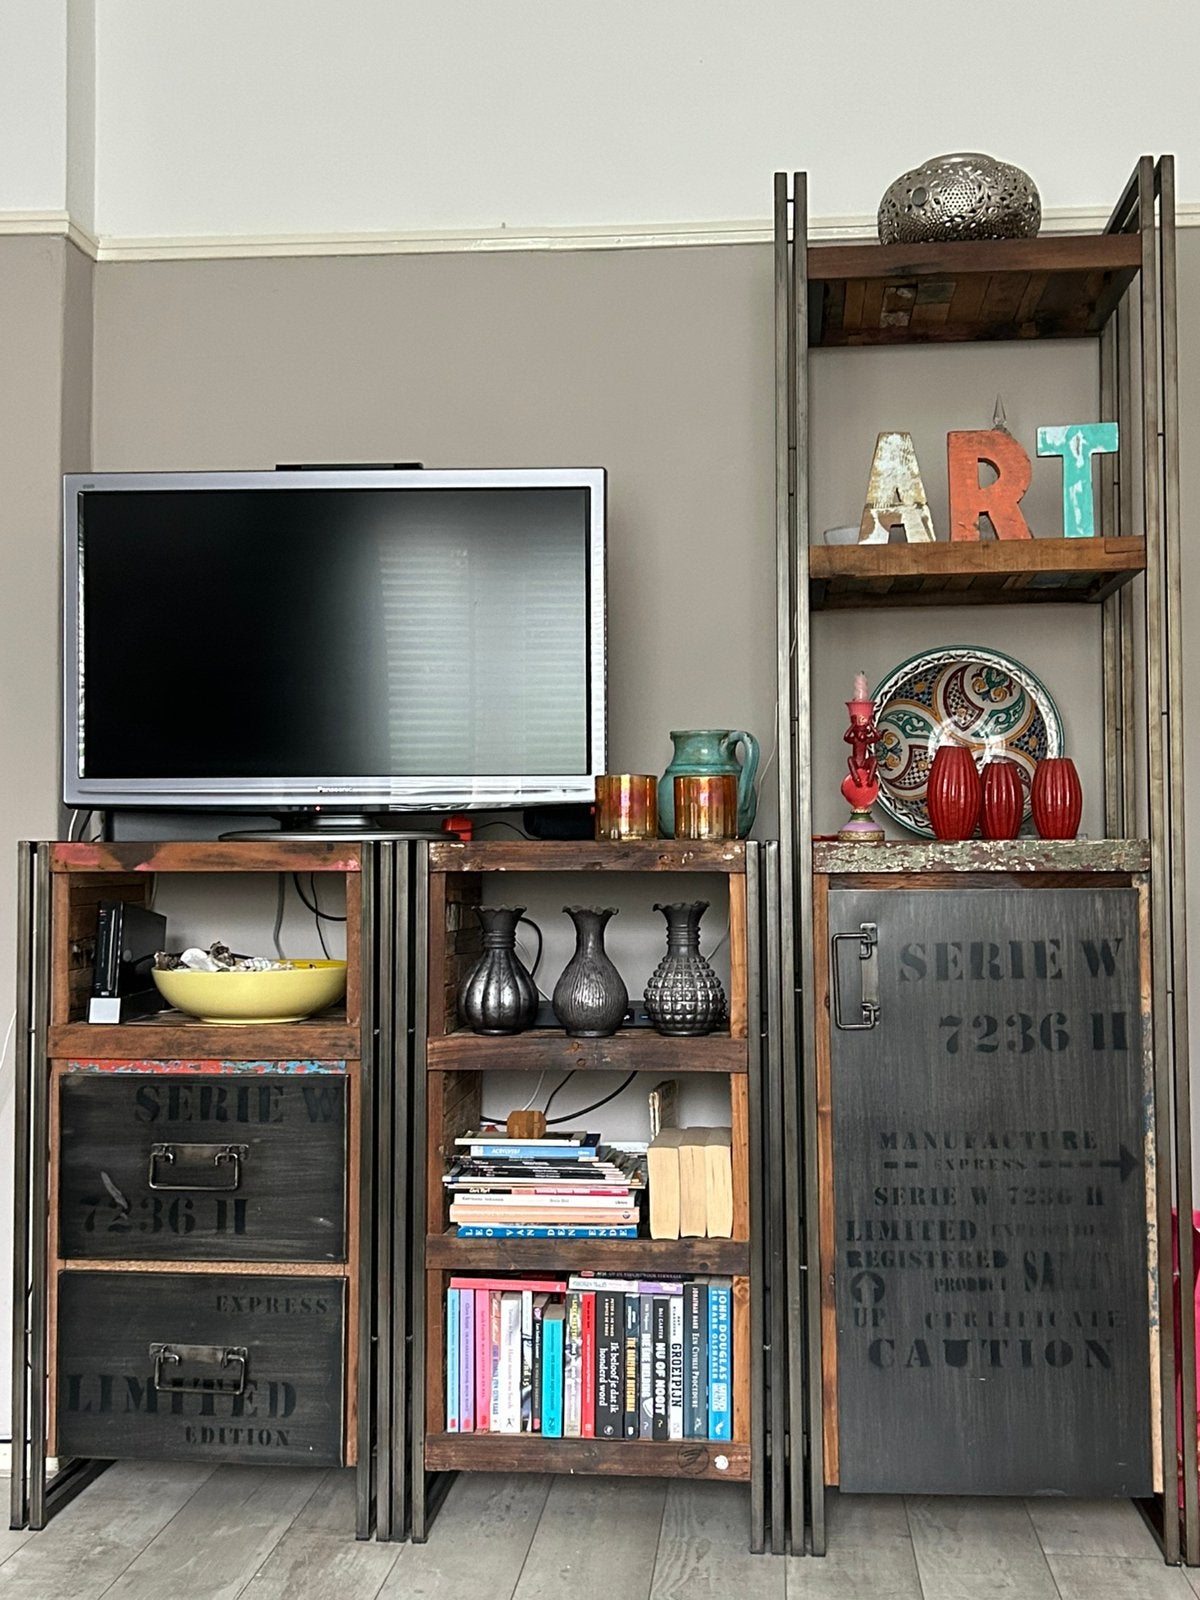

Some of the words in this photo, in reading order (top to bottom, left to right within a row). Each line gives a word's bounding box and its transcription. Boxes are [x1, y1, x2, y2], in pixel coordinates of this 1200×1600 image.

[858, 422, 1119, 545] ART
[898, 939, 1062, 981] SERIE
[1080, 938, 1123, 977] W
[939, 1012, 1069, 1054] 7236
[134, 1085, 284, 1123] SERIE
[303, 1086, 341, 1123] W
[880, 1131, 1097, 1149] MANUFACTURE
[935, 1159, 1027, 1170] EXPRESS
[874, 1187, 956, 1206] SERIE
[971, 1187, 990, 1206] W
[80, 1197, 195, 1234] 7236
[465, 1229, 494, 1237] LEO
[506, 1229, 535, 1237] VAN
[548, 1229, 576, 1237] DEN
[589, 1229, 628, 1237] ENDE
[846, 1220, 977, 1241] LIMITED
[847, 1250, 1008, 1269] REGISTERED
[216, 1295, 329, 1314] EXPRESS
[712, 1290, 718, 1301] EN
[718, 1290, 727, 1320] JOHN
[854, 1308, 886, 1327] UP
[610, 1342, 619, 1351] Ik
[655, 1343, 665, 1359] NU
[718, 1324, 727, 1380] DOUGLAS
[869, 1339, 1113, 1369] CAUTION
[599, 1348, 608, 1383] honderd
[610, 1353, 619, 1380] beloof
[655, 1361, 665, 1377] OF
[672, 1343, 682, 1407] GROEIPIJN
[608, 1380, 619, 1388] je
[67, 1374, 297, 1418] LIMITED
[599, 1385, 608, 1406] word
[610, 1389, 619, 1403] dat
[655, 1380, 665, 1415] NOOIT
[610, 1404, 619, 1413] ik
[185, 1427, 290, 1446] EDITION
